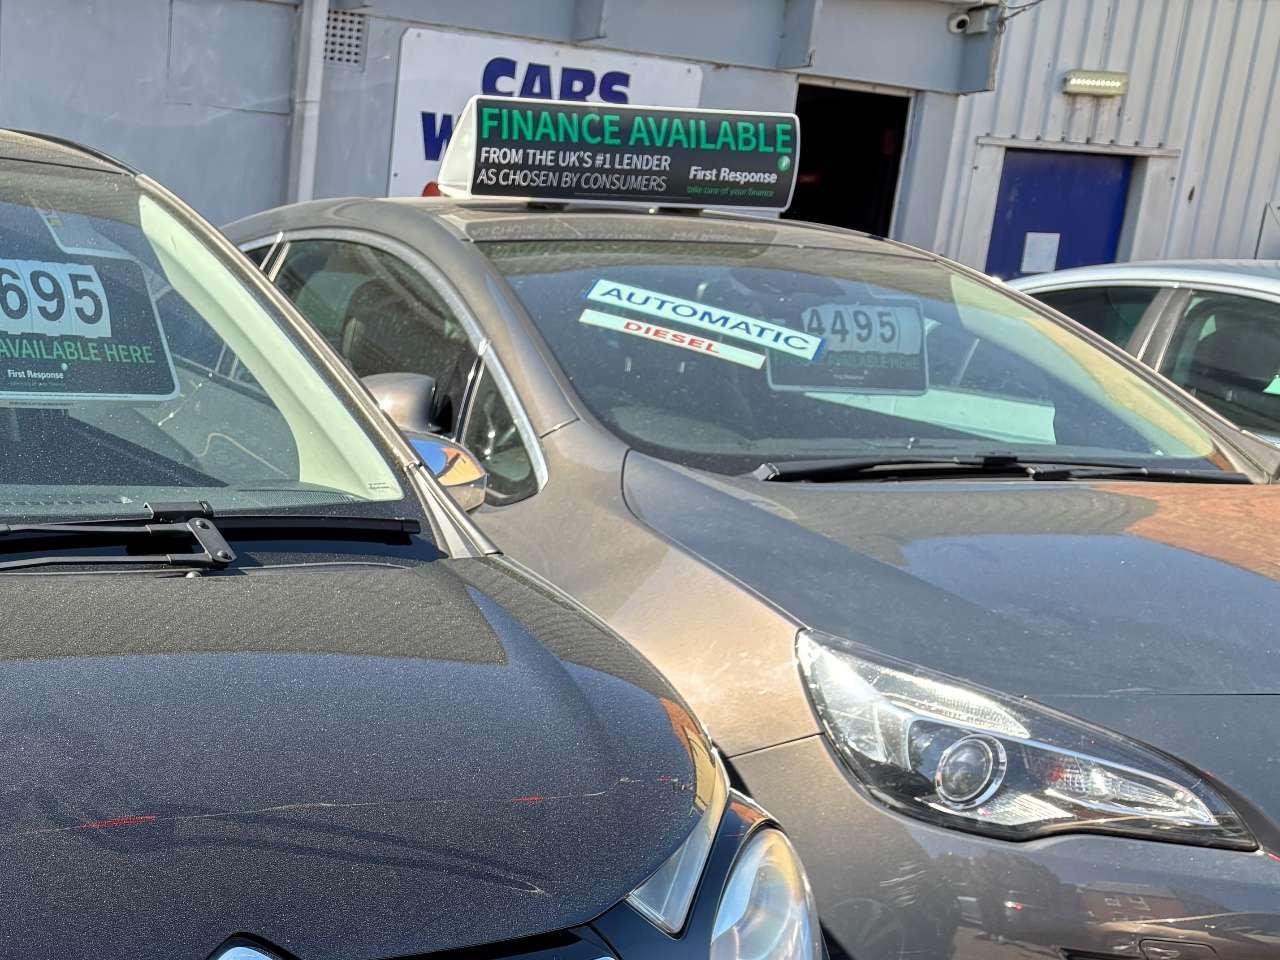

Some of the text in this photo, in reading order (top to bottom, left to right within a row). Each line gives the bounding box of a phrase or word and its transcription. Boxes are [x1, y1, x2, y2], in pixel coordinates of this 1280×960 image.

[481, 57, 631, 105] CARS
[481, 108, 620, 145] FINANCE
[629, 116, 792, 153] AVAILABLE
[480, 147, 671, 171] FROM THE UK'S #1 LENDER
[477, 168, 668, 192] AS CHOSEN BY CONSUMERS
[689, 166, 778, 185] First Response
[601, 288, 809, 350] AUTOMATIC
[806, 308, 897, 344] 4495
[623, 321, 721, 354] DIESEL
[104, 344, 155, 364] HERE
[7, 369, 64, 380] First Response
